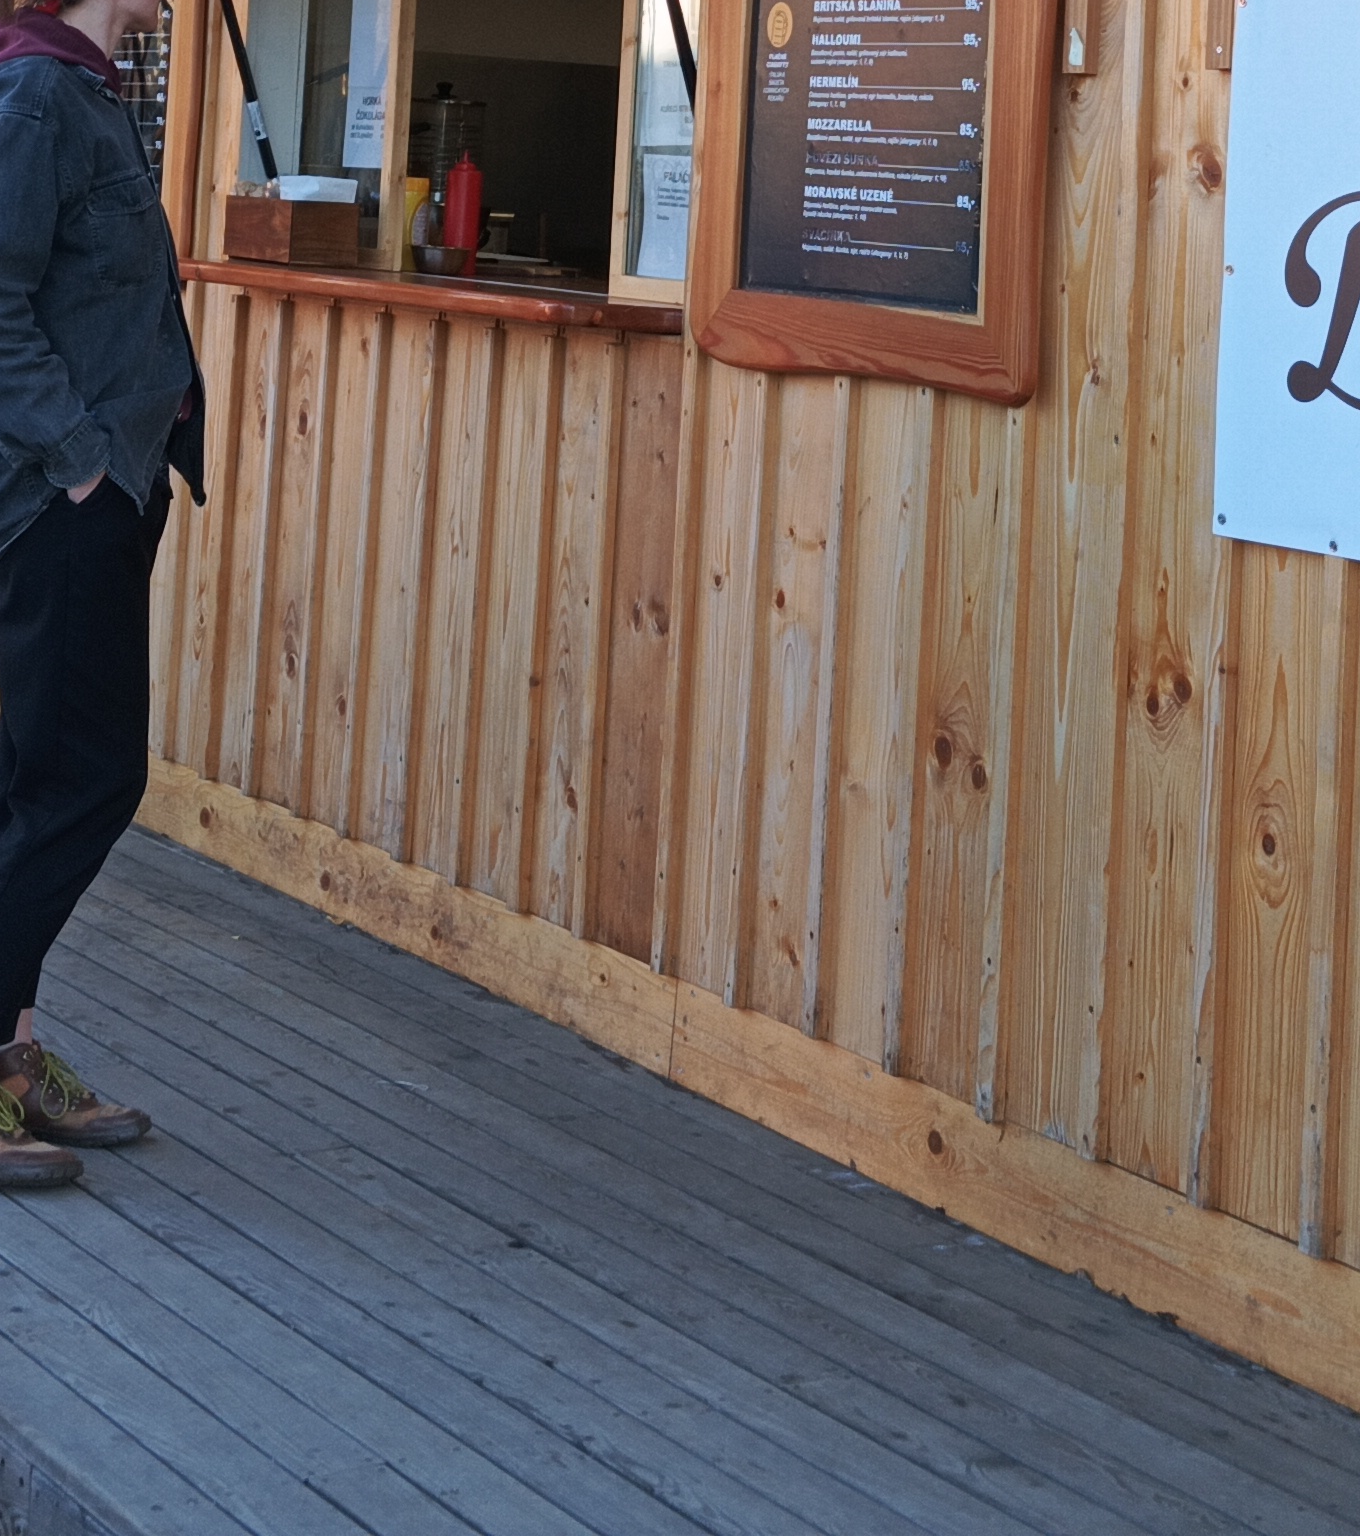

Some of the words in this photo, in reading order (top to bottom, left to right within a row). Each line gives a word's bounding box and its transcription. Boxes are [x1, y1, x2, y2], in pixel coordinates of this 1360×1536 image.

[857, 0, 901, 12] SLANINA
[811, 33, 862, 46] HALLOUMI
[807, 118, 873, 132] MOZZARELLA
[804, 185, 858, 201] MORAVSKÉ
[859, 187, 894, 203] UZENÉ
